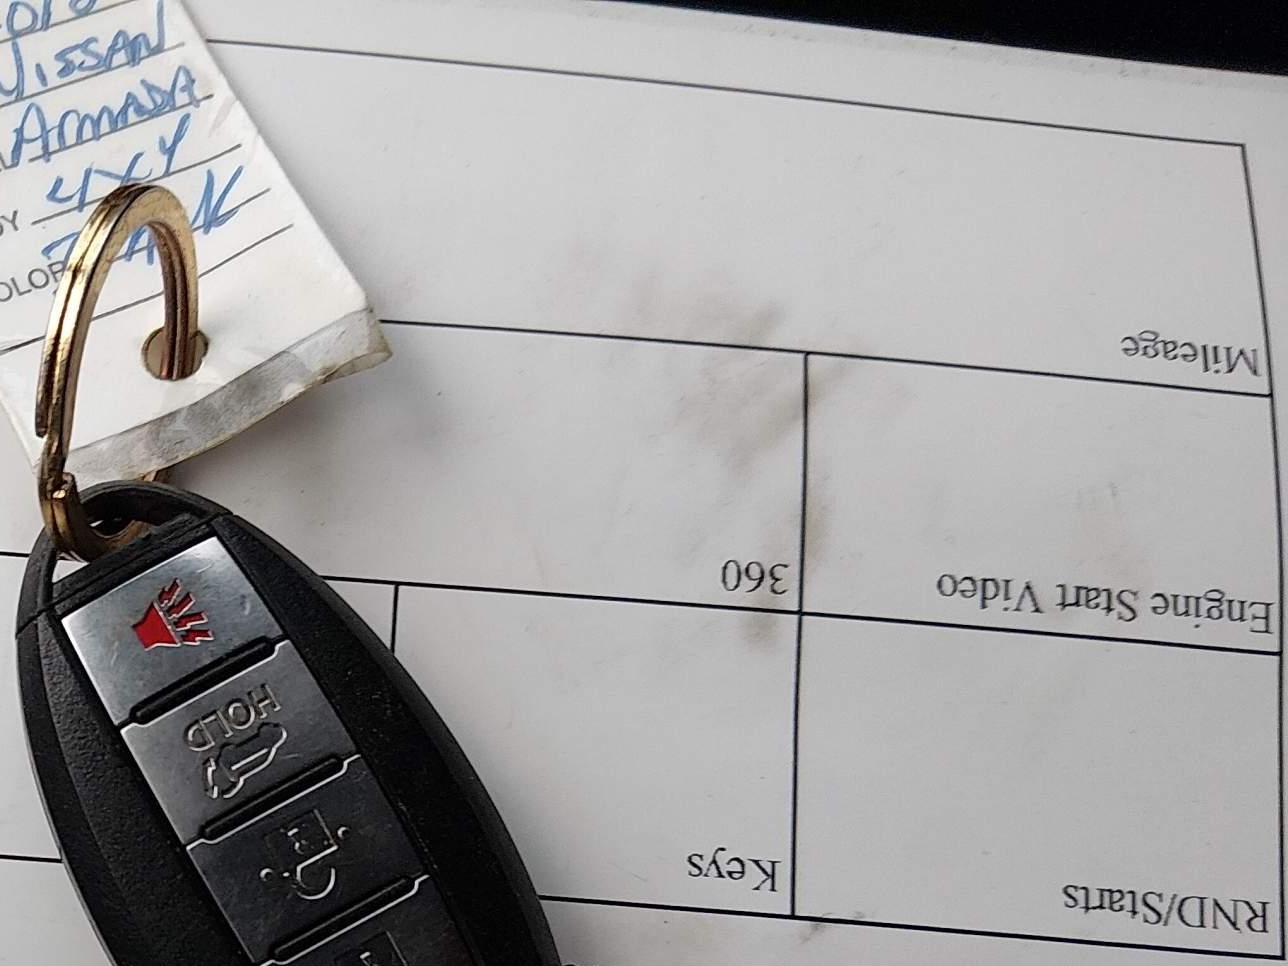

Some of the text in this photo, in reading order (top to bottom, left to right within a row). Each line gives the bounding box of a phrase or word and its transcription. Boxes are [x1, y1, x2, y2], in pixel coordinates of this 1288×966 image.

[1120, 330, 1262, 377] Mileage
[721, 559, 789, 595] 360
[936, 573, 1275, 634] Engine Start Video
[184, 684, 281, 752] HOLD
[686, 847, 781, 891] Keys
[1062, 884, 1270, 933] RND/Starts
